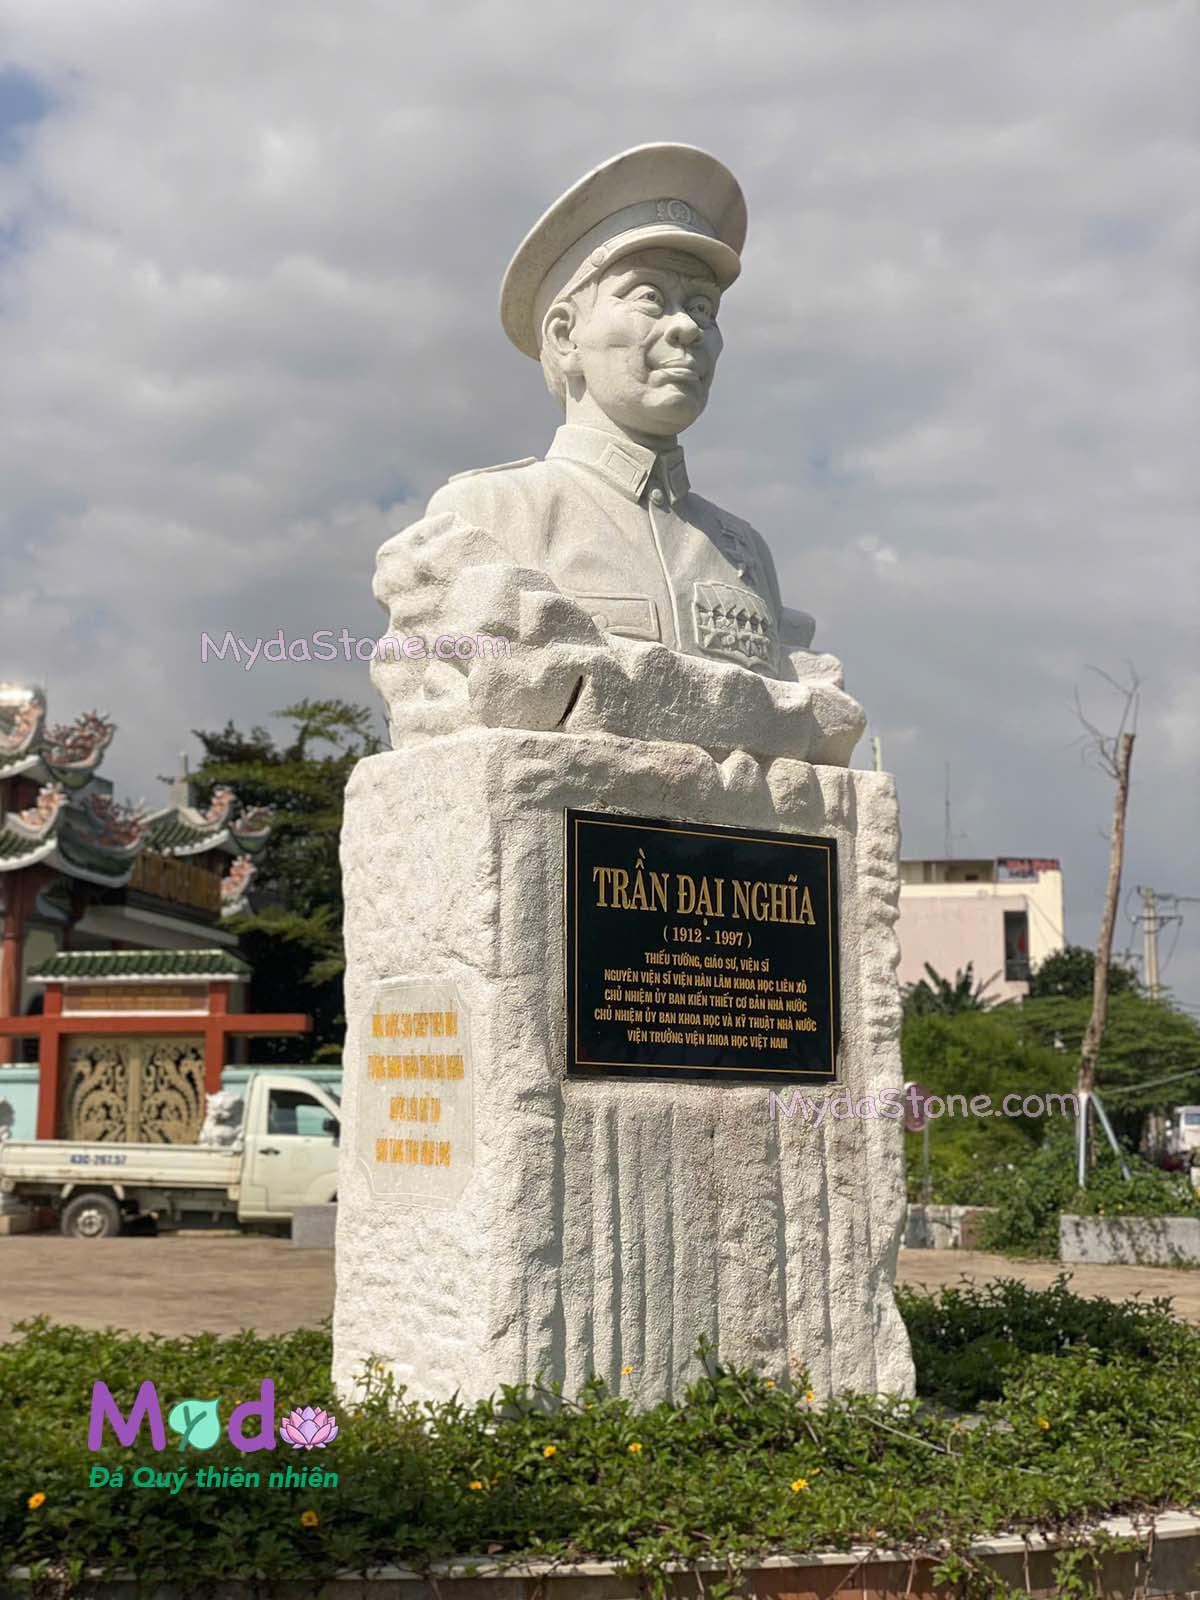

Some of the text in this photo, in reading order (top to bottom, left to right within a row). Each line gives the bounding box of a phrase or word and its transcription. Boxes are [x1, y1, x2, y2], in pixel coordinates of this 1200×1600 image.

[593, 848, 816, 926] TRẦN ĐẠI NGHĨA
[644, 949, 770, 973] THIẾU TƯỚNG, GIÁO SƯ, VIỆN SĨ
[604, 968, 807, 994] NGUYÊN VIỆN SĨ VIỆN HÀN LÂM KHOA HỌC LIÊN XÔ
[604, 985, 808, 1012] CHỦ NHIỆM ỦY BAN KIẾN THIẾT CƠ BẢN NHÀ NƯỚC
[594, 1005, 817, 1032] CHỦ NHIỆM ỦY BAN KHOA HỌC VÀ KỸ THUẬT NHÀ NƯỚC
[627, 1027, 788, 1050] VIỆN TRƯỞNG VIỆN KHOA HỌC VIỆT NAM
